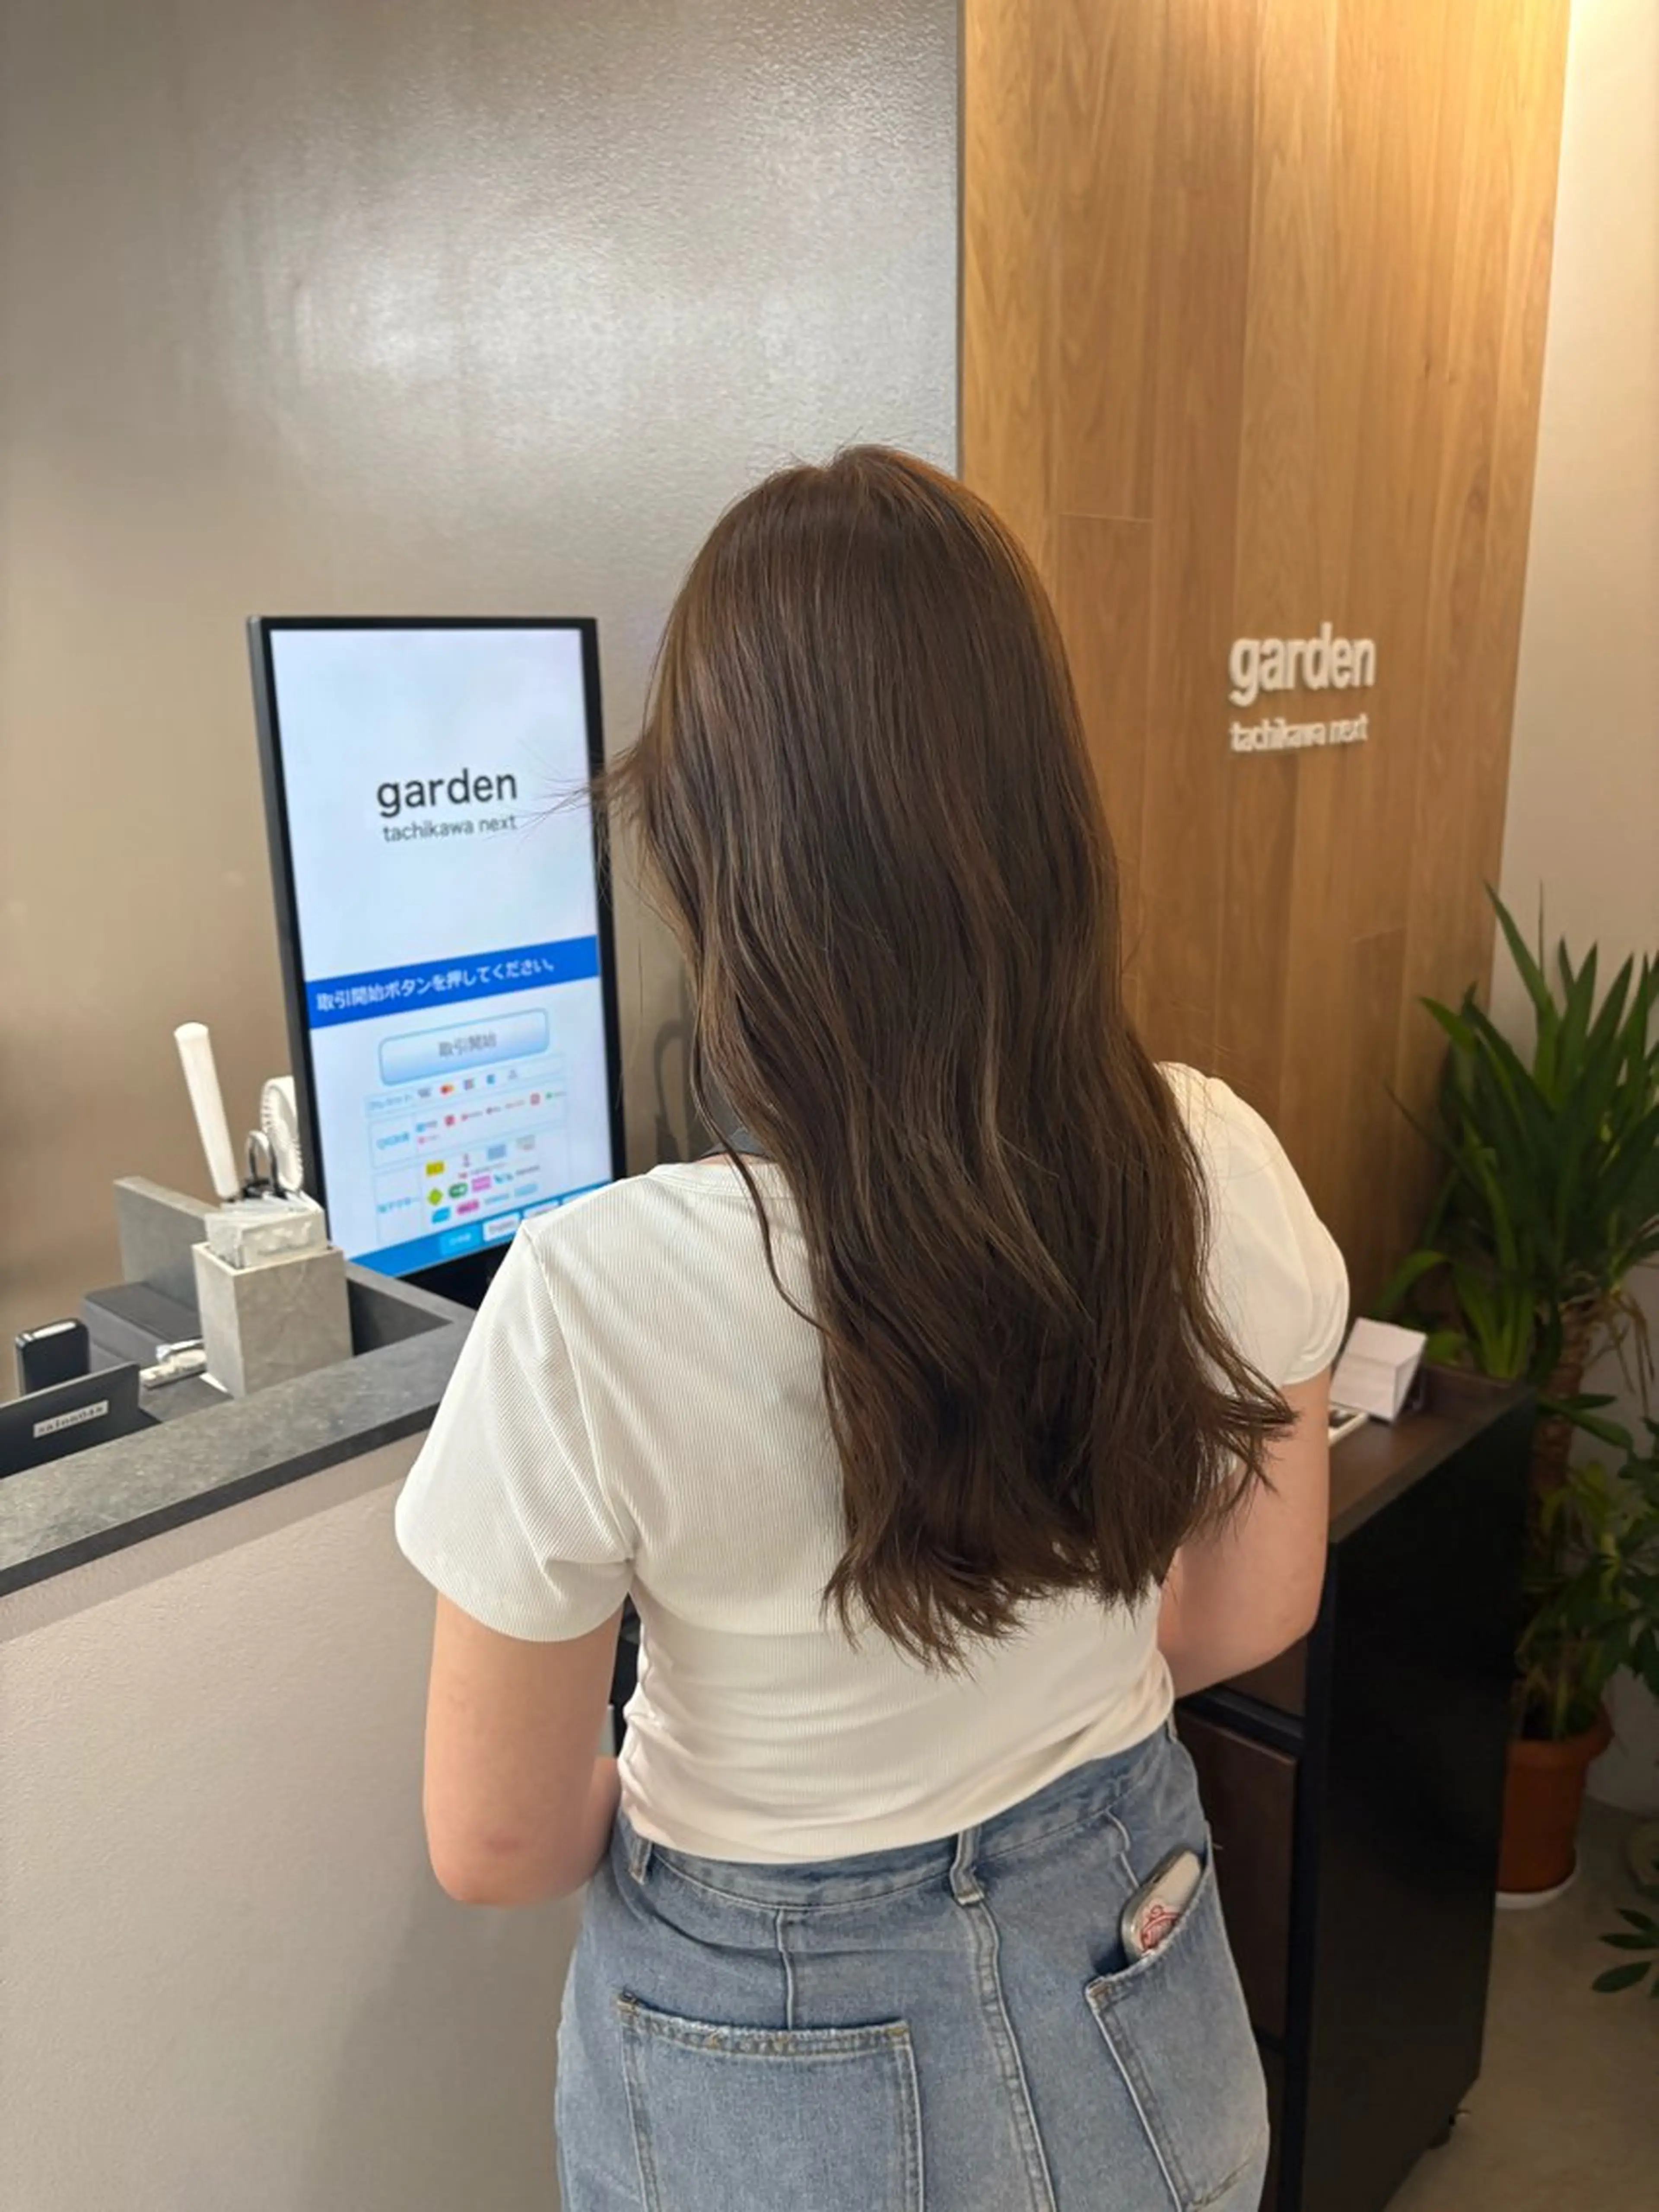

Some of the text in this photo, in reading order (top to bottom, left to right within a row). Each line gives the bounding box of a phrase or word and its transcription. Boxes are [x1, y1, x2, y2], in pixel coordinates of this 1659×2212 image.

[1229, 621, 1376, 707] garden
[377, 767, 517, 818] garden
[383, 814, 517, 842] tachikawa next
